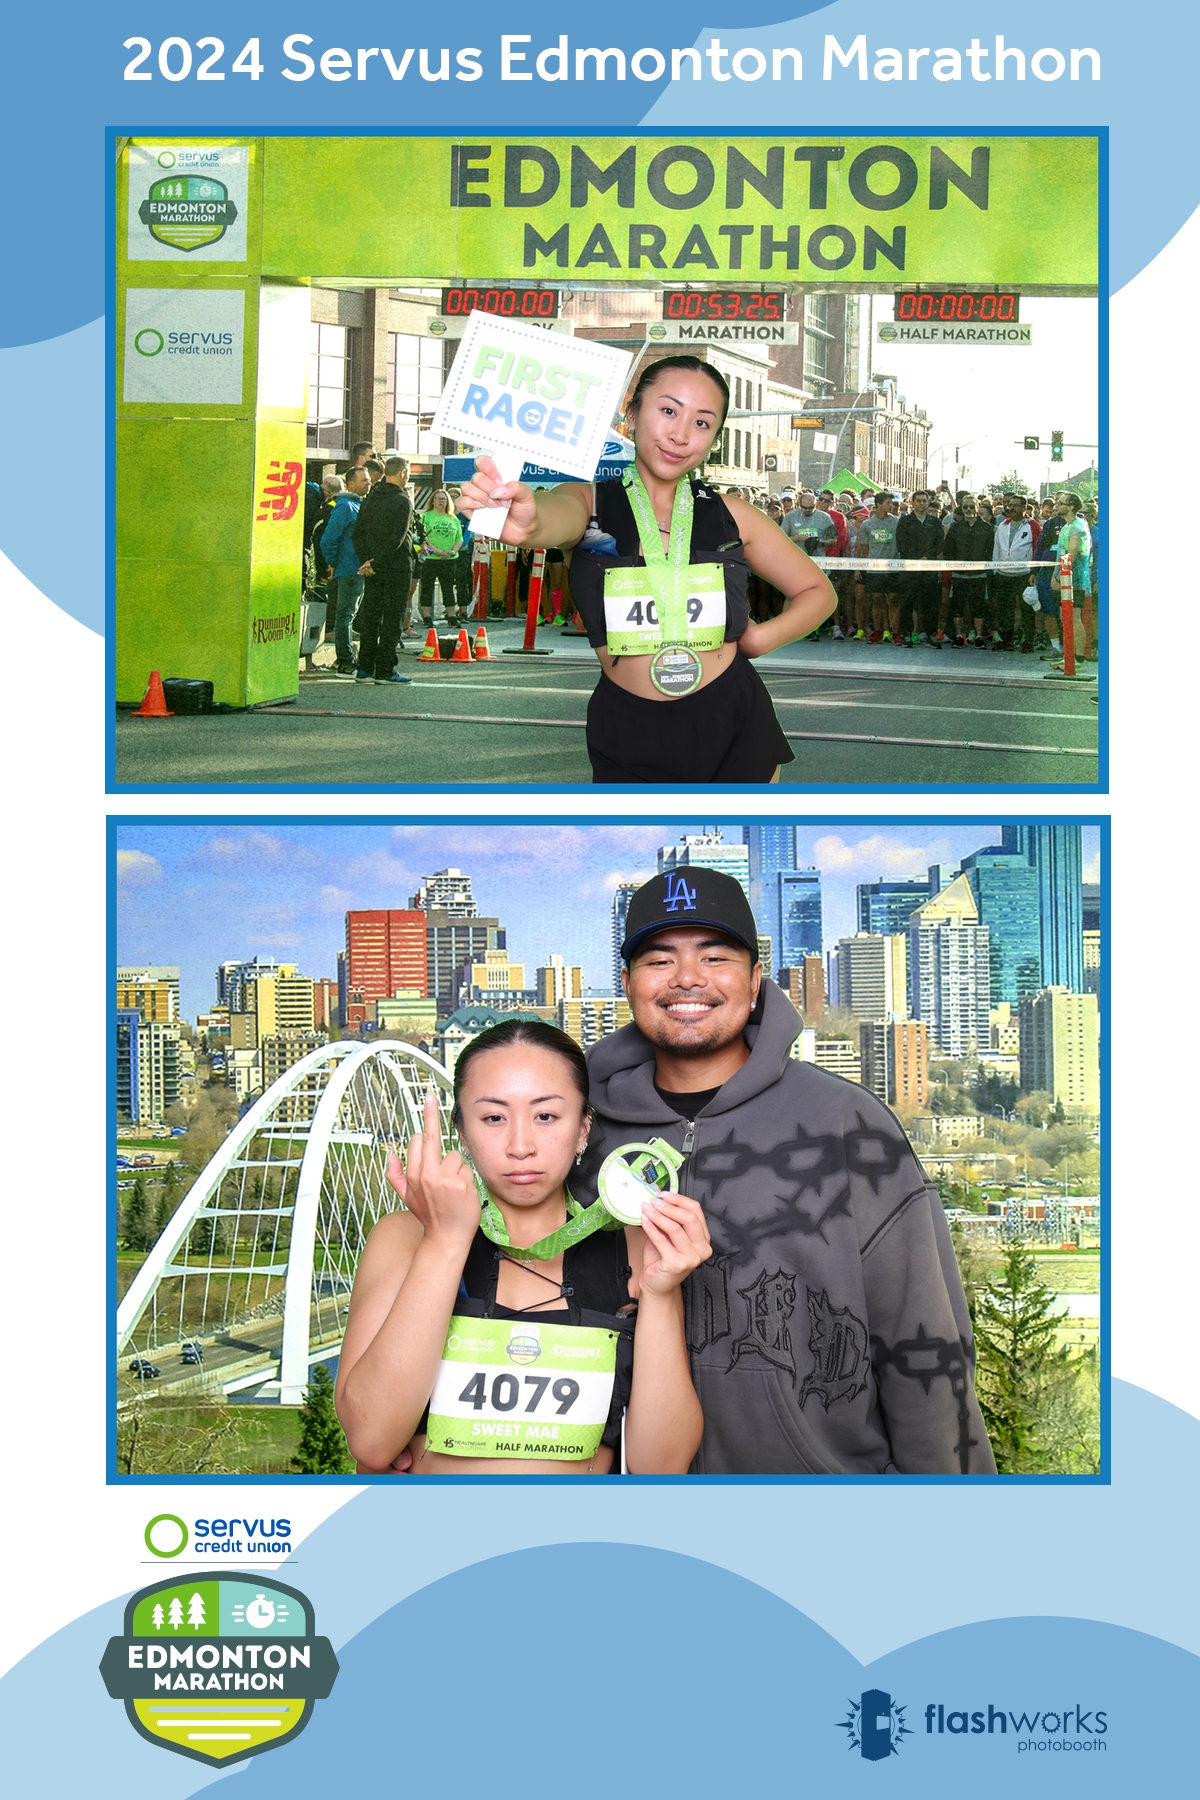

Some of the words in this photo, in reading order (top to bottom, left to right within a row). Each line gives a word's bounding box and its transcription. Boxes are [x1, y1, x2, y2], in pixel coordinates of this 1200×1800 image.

[178, 152, 219, 162] servus
[450, 144, 991, 211] EDMONTON
[149, 203, 227, 214] EDMONTON
[160, 213, 216, 223] MARATHON
[523, 222, 907, 271] MARATHON
[168, 331, 234, 345] servus
[679, 325, 785, 340] MARATHON
[900, 327, 939, 340] HALF
[943, 328, 1031, 341] MARATHON
[168, 344, 200, 355] credit
[203, 346, 233, 355] union
[472, 344, 602, 407] FIRST
[460, 383, 586, 446] RACE!
[626, 597, 703, 626] 409
[257, 614, 290, 642] Running
[637, 630, 663, 642] SWEE
[663, 872, 697, 913] LA
[462, 1338, 495, 1348] servus
[458, 1372, 580, 1415] 4079
[472, 1422, 522, 1438] SWEET
[526, 1425, 560, 1439] MAE
[496, 1442, 521, 1451] HALF
[524, 1443, 584, 1454] MARATHON
